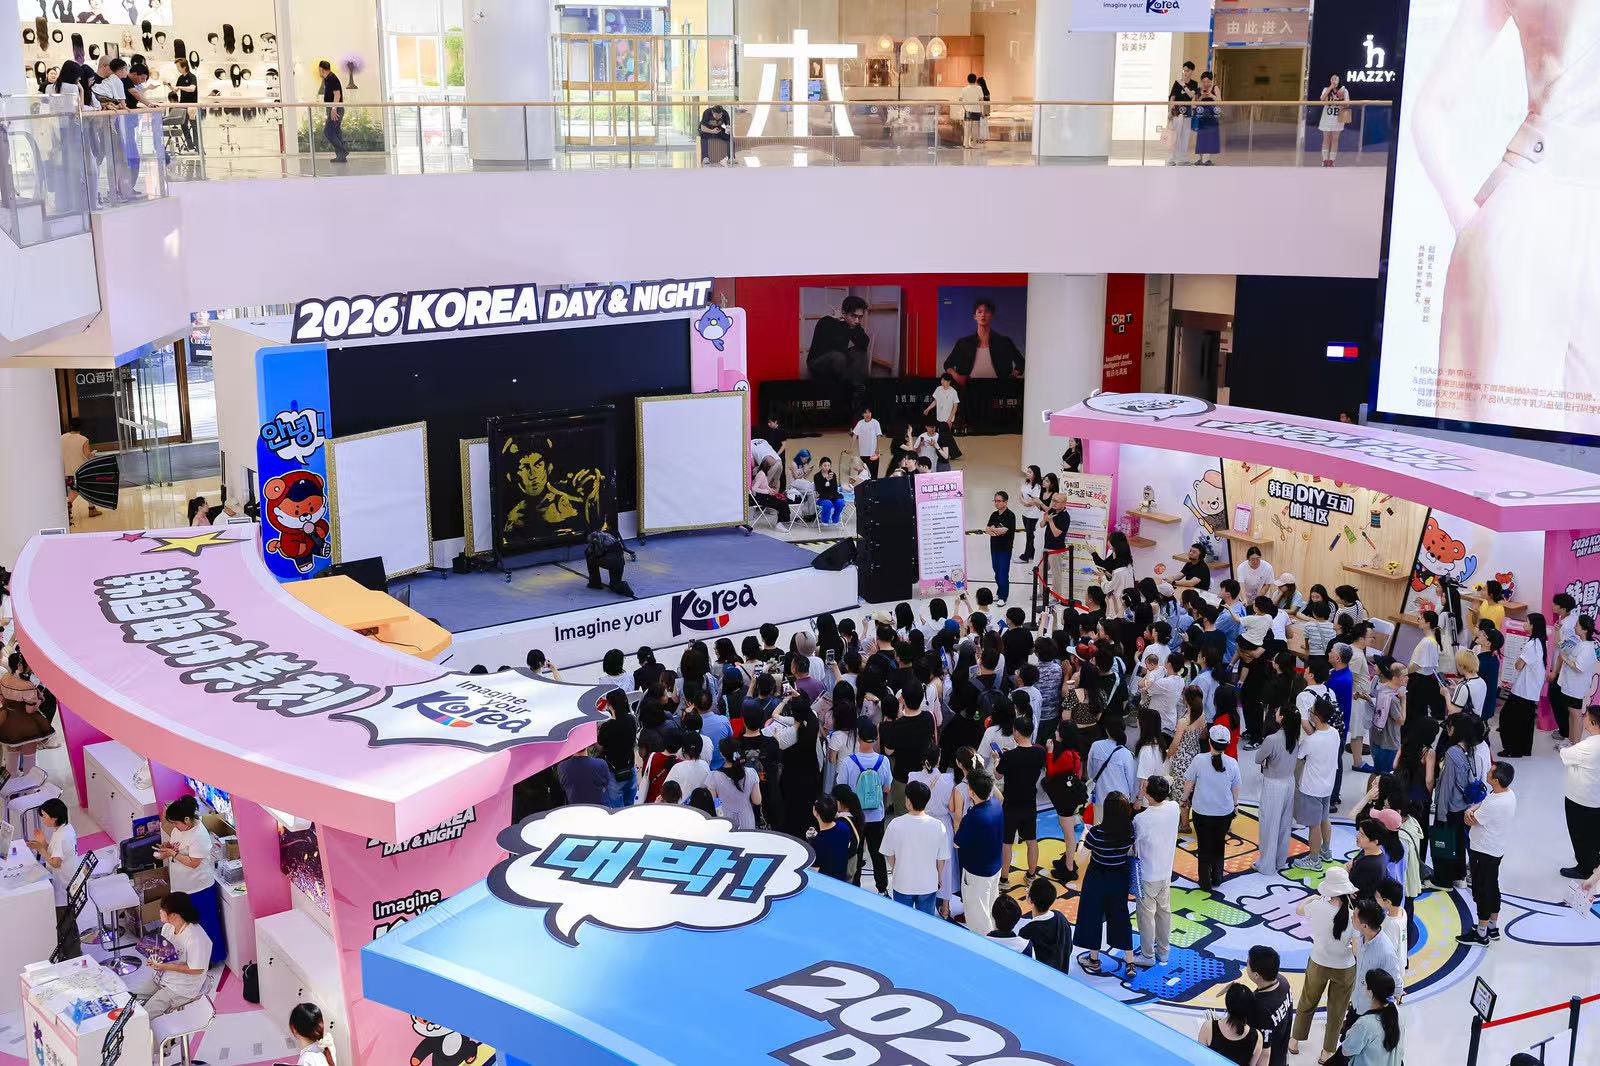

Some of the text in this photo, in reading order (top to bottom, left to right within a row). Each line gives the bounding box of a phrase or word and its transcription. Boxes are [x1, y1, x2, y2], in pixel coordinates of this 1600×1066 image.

[1146, 0, 1180, 13] Korea
[1227, 20, 1294, 35] 由此进入
[1347, 71, 1396, 82] HAZZY
[296, 281, 711, 340] 2026 KOREA DAY & NIGHT
[261, 412, 325, 450] 안녕!
[1290, 502, 1329, 525] 体验区
[554, 583, 758, 642] Imagine your Korea
[456, 680, 527, 705] Imagine
[480, 698, 532, 714] your
[392, 690, 532, 733] Korea
[383, 842, 411, 856] DAY
[411, 834, 423, 848] &
[423, 824, 465, 845] NIGHT
[541, 836, 776, 900] 대박!
[375, 890, 440, 918] Imagine
[766, 966, 1058, 1066] 202
